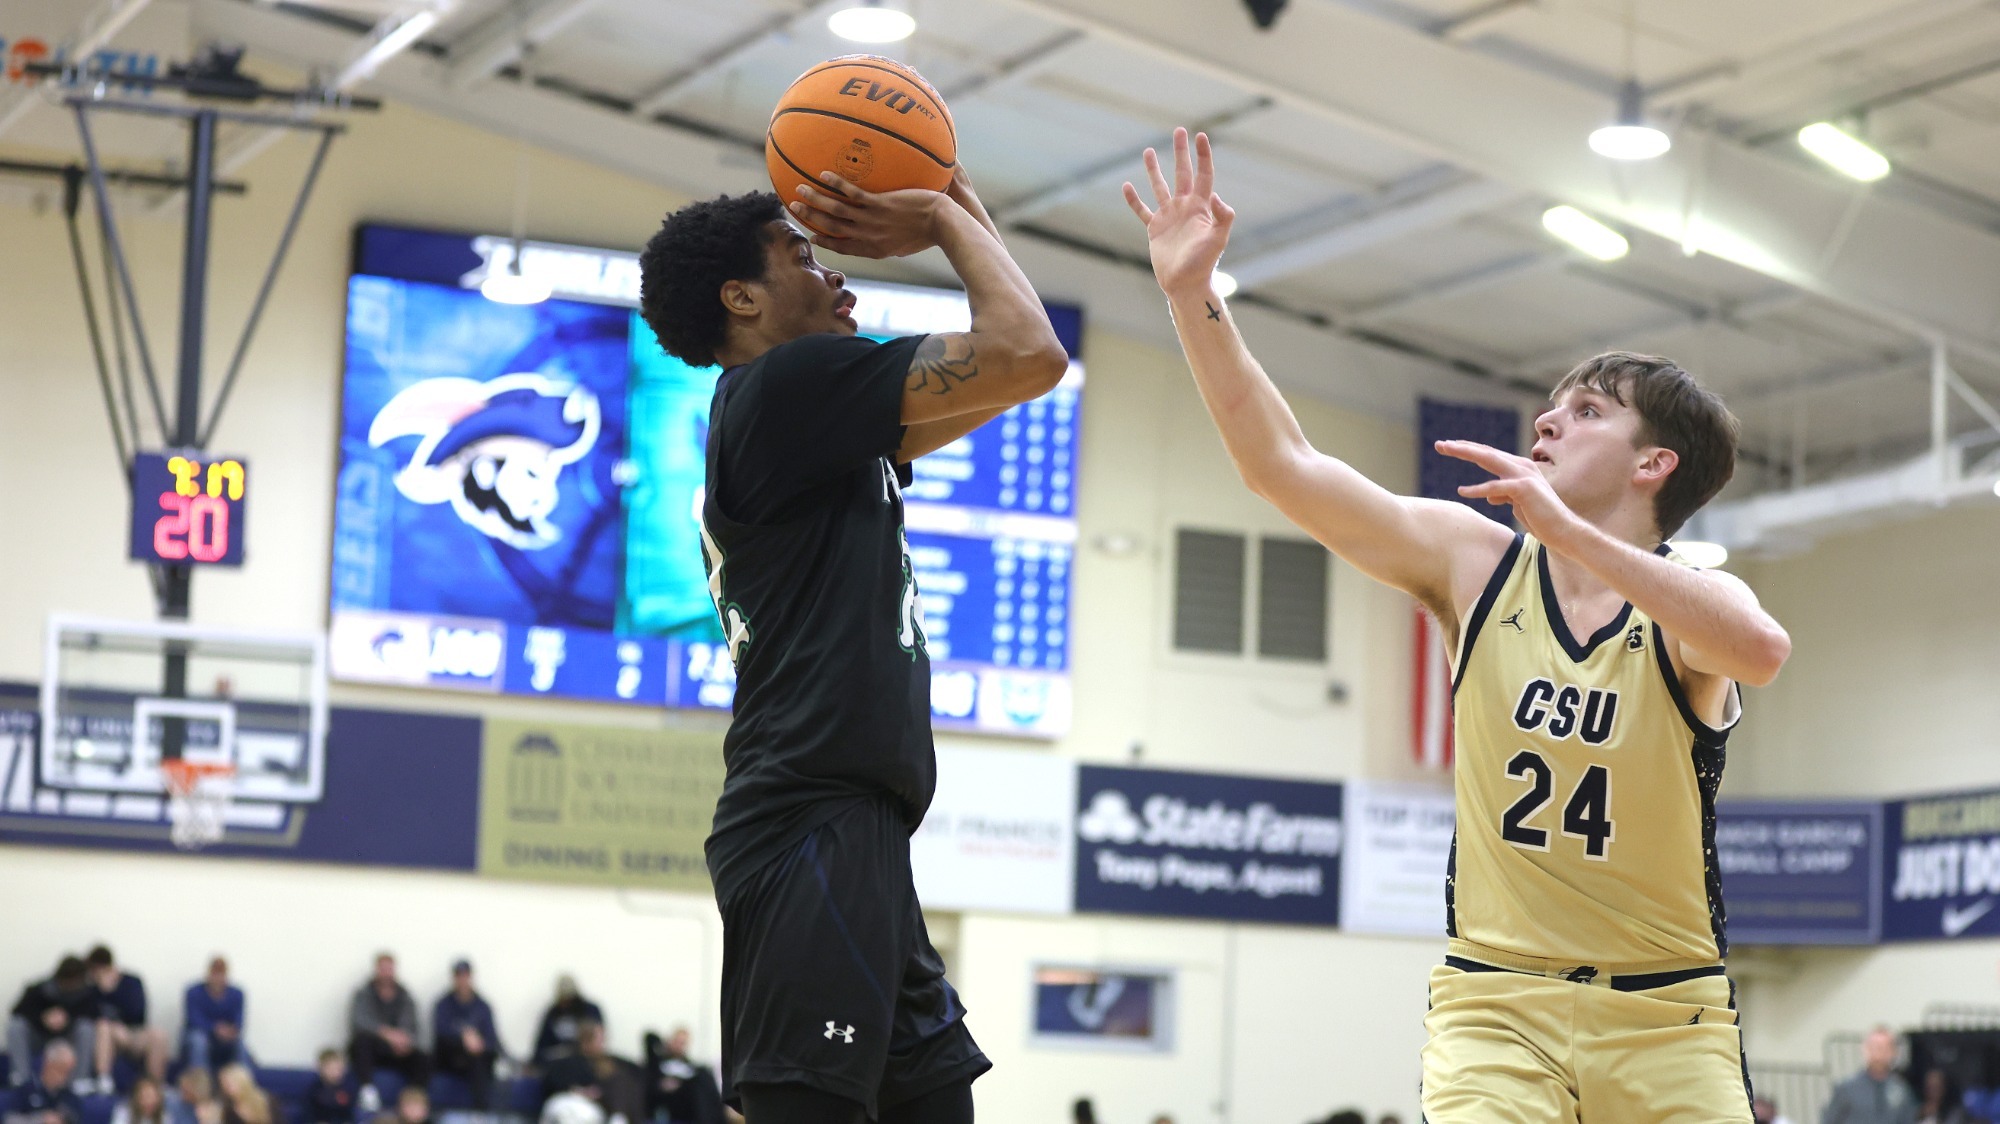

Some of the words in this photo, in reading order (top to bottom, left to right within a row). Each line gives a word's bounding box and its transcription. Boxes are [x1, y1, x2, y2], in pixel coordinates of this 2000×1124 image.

[838, 77, 917, 115] EVO
[916, 104, 946, 121] NXT
[153, 491, 229, 562] 20
[1512, 676, 1620, 746] CSU
[1502, 749, 1615, 862] 24
[503, 839, 611, 873] DINING
[1095, 852, 1157, 891] Tony
[1237, 860, 1323, 898] Agent
[1891, 843, 1961, 902] JUST
